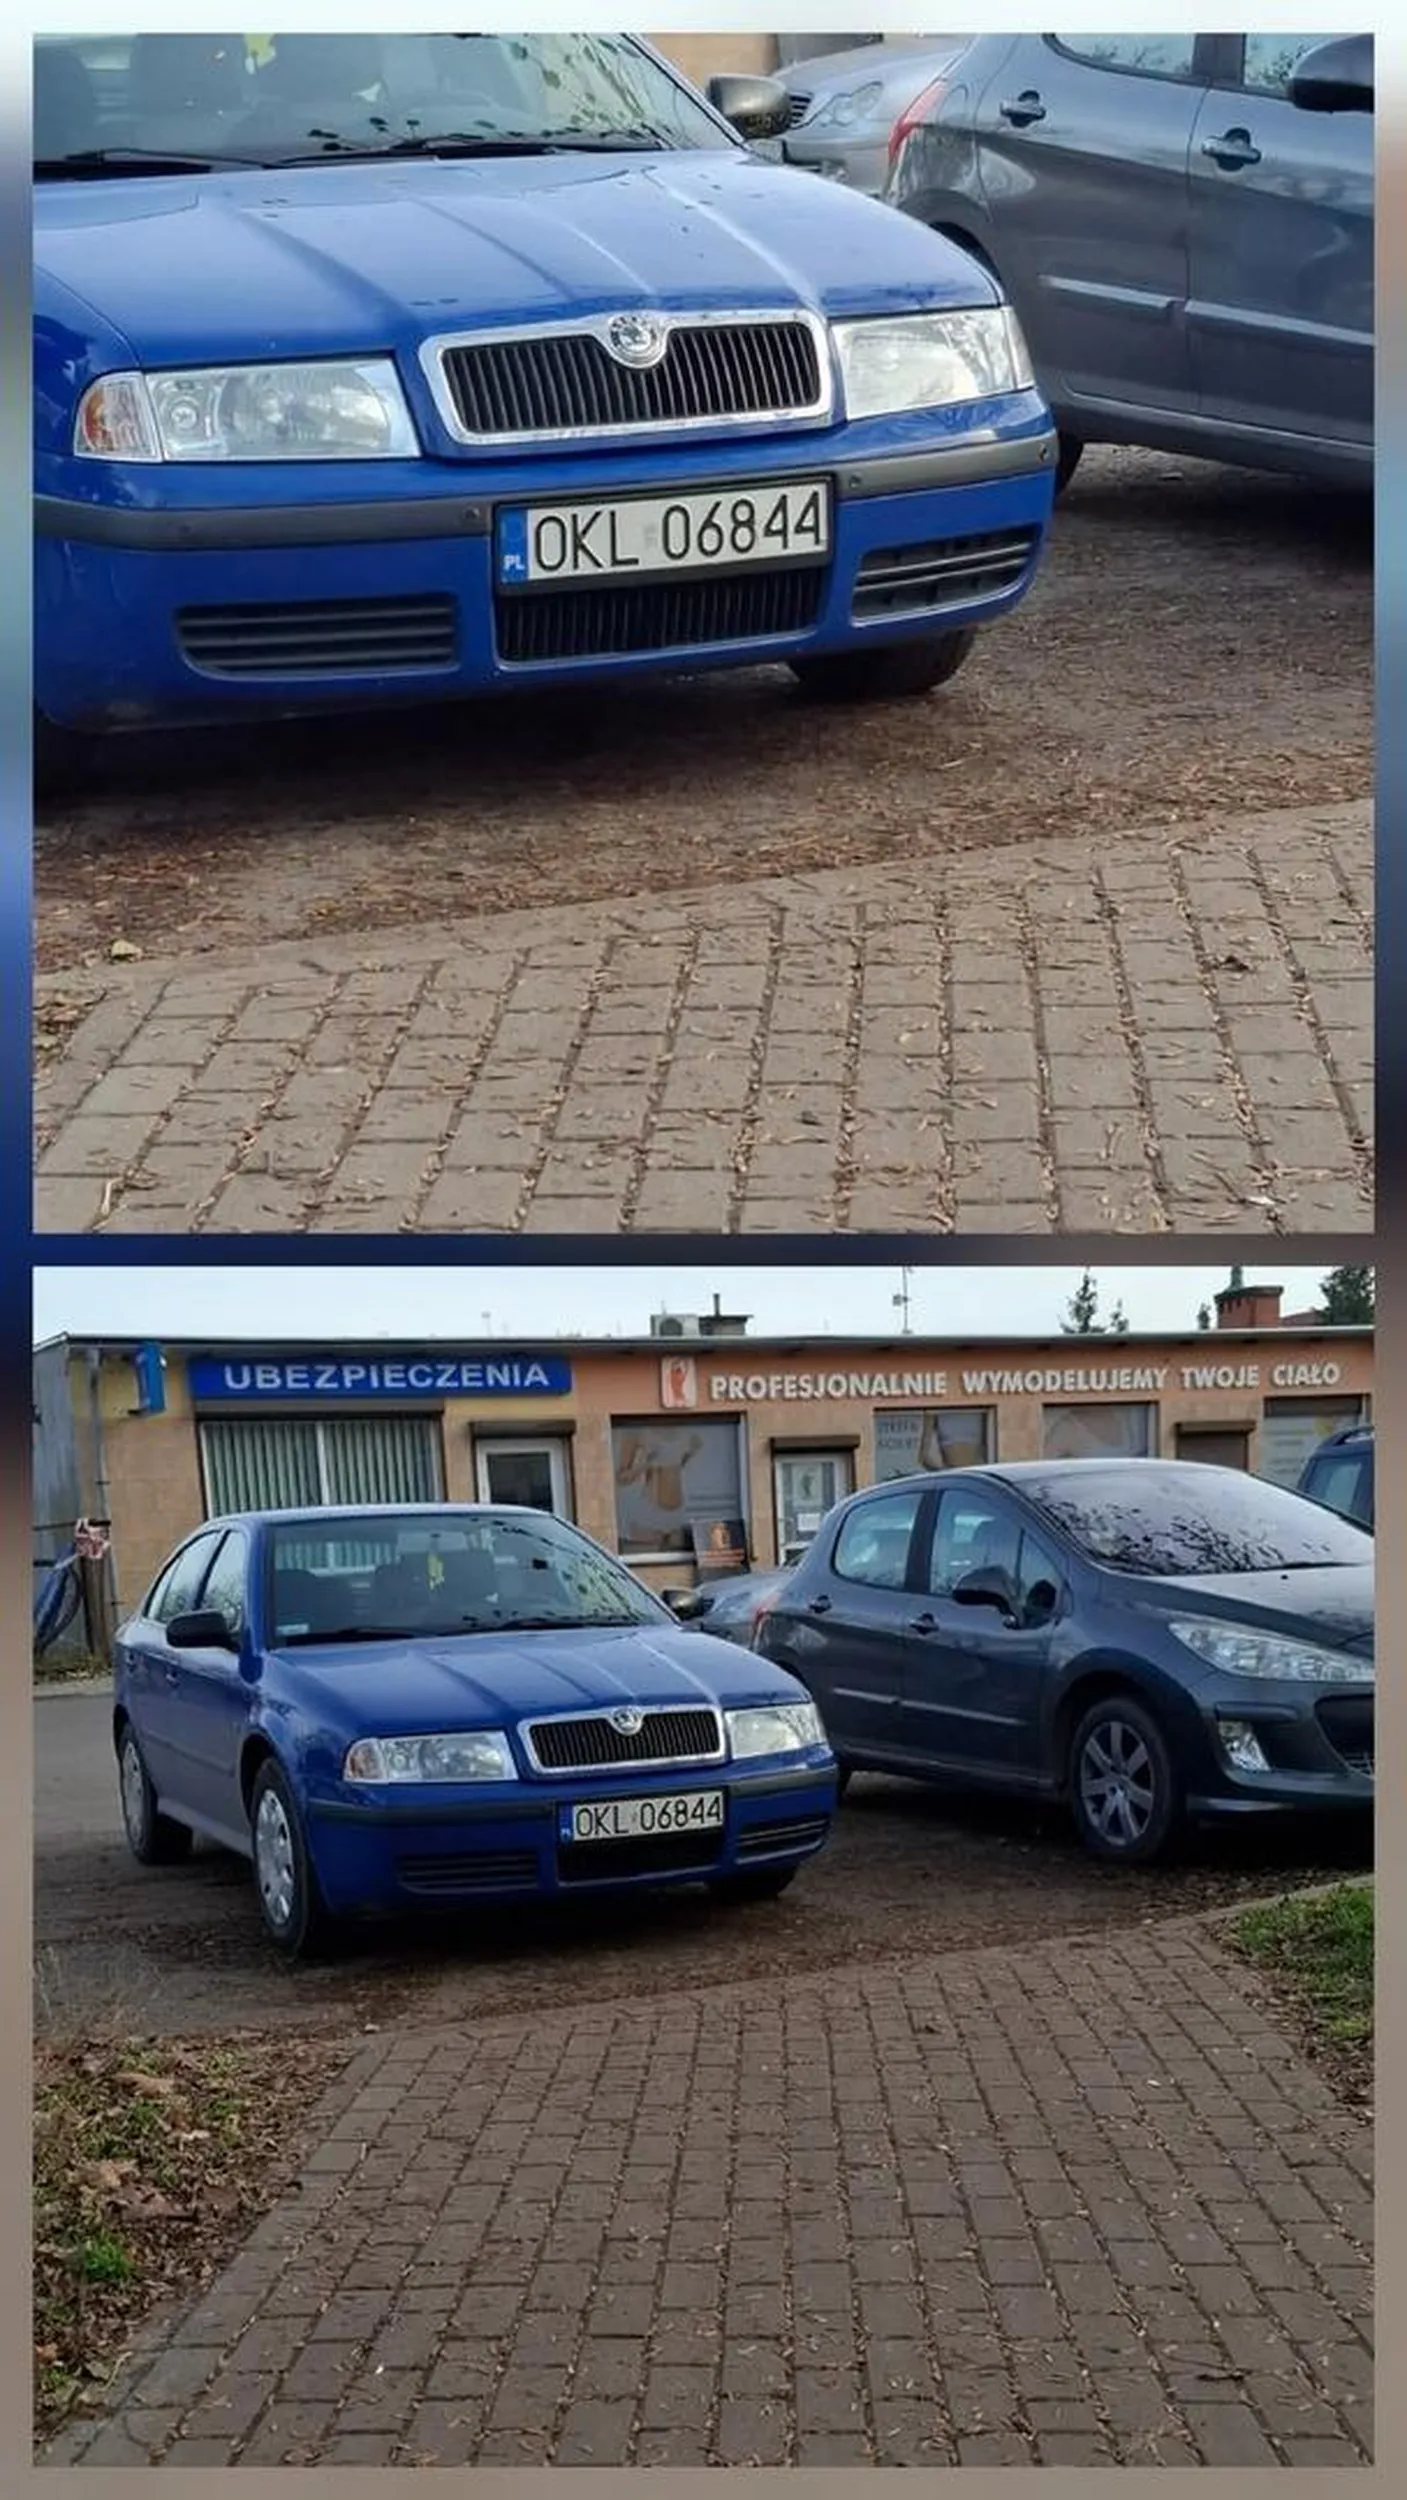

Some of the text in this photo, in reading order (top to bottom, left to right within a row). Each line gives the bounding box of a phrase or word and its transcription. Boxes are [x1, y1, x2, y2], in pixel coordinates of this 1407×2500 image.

[534, 490, 822, 572] OKL 06844
[503, 553, 525, 571] PL
[223, 1363, 550, 1391] UBEZPIECZENIA
[711, 1362, 1341, 1399] PROFESJONALNIE WYMODELUJEMY TWOJE CIAŁO
[576, 1796, 722, 1837] OKL 06844
